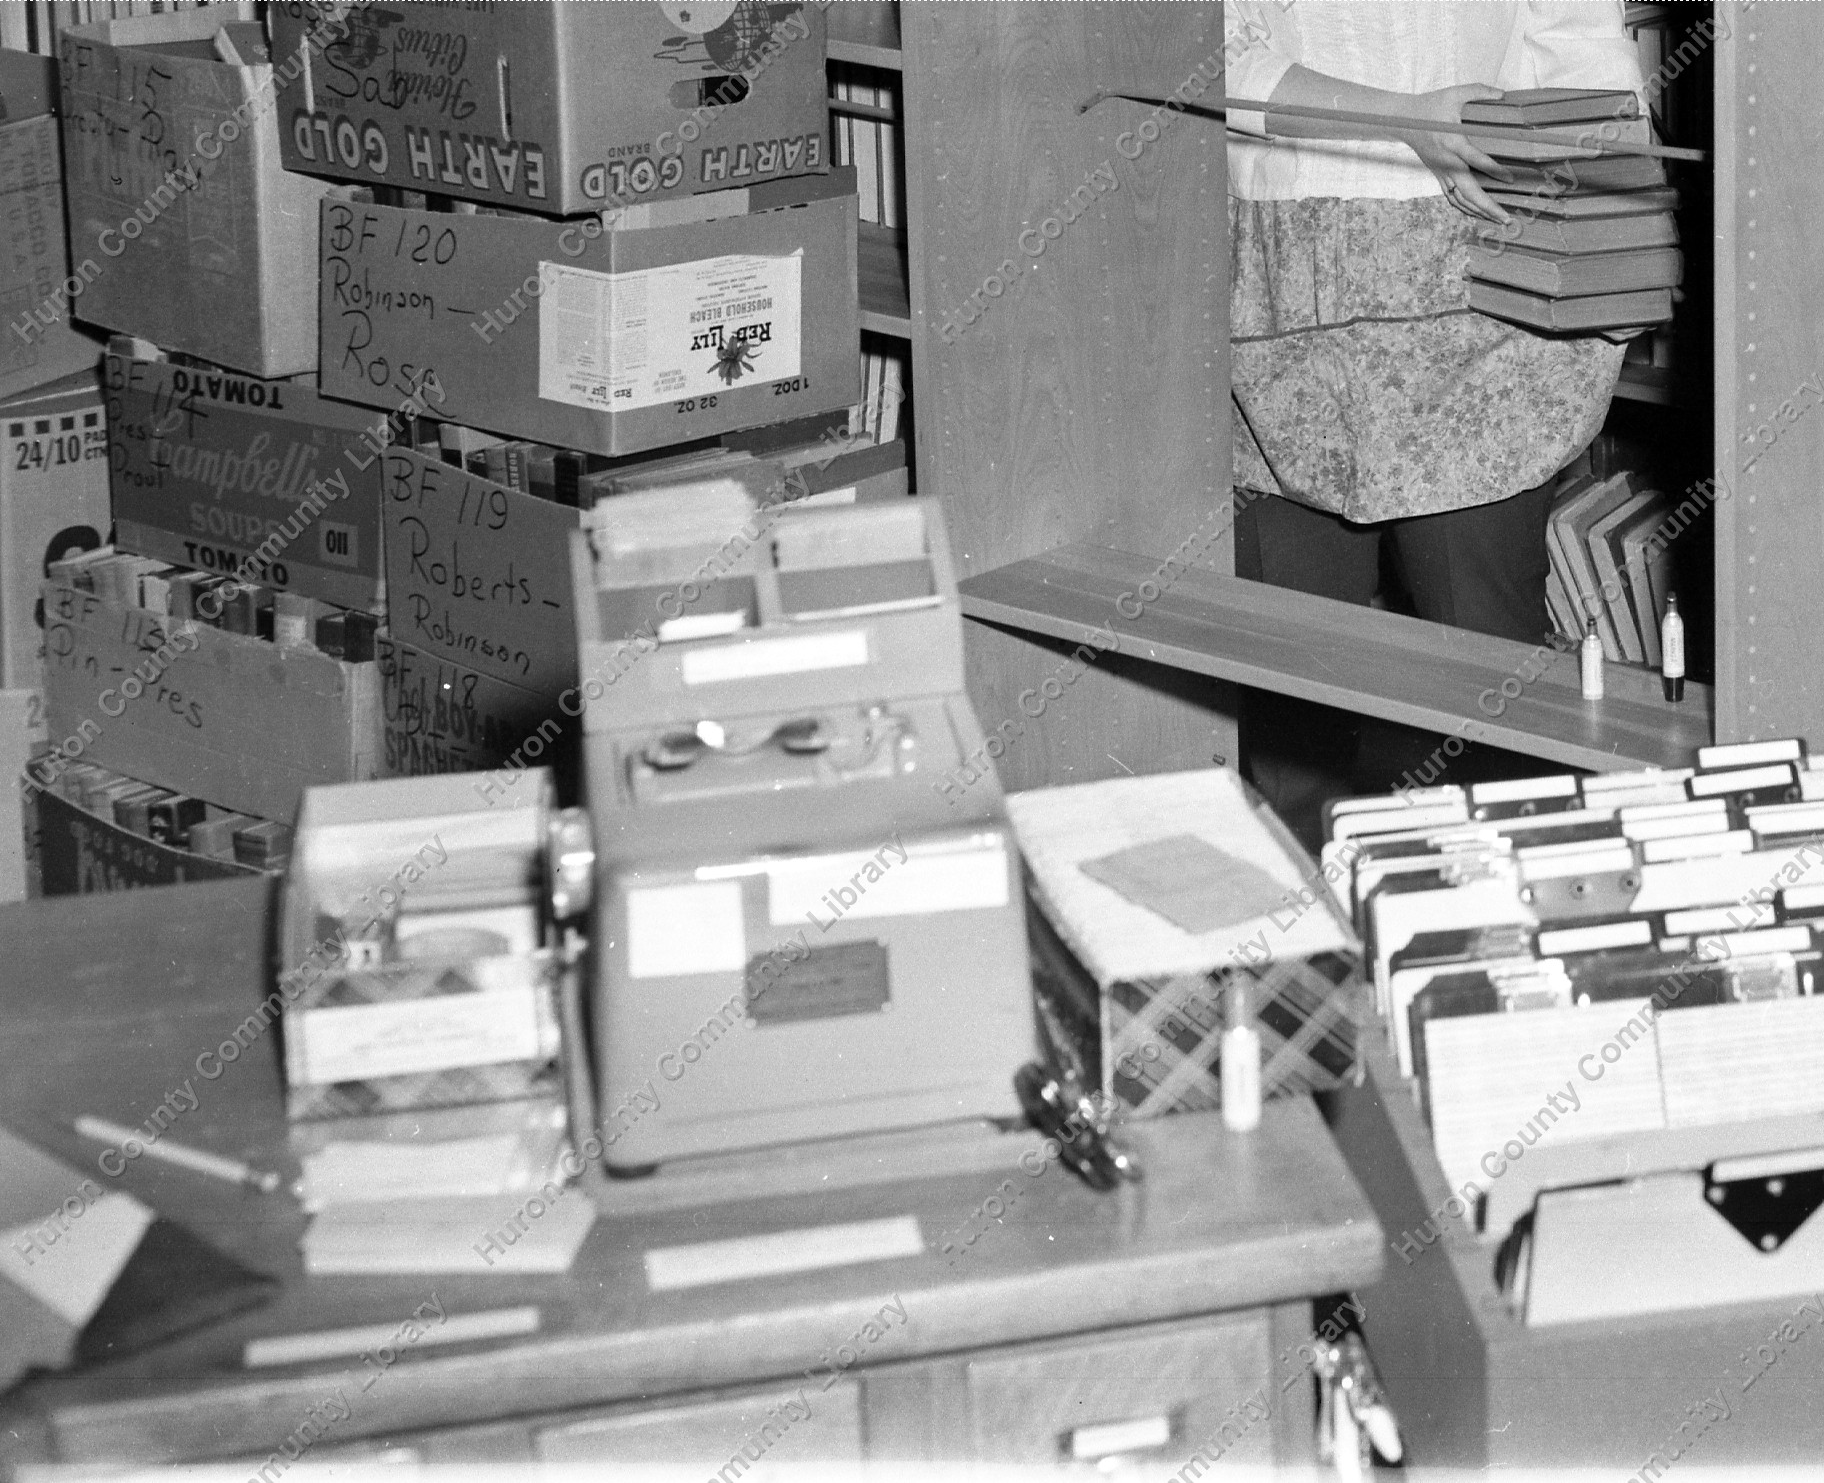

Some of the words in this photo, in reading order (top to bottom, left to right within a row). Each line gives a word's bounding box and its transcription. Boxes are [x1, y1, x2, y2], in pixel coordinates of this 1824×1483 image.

[399, 26, 468, 76] Citrus
[293, 109, 389, 175] GOLD
[404, 123, 548, 200] EARTH
[701, 133, 824, 185] EARTH
[580, 152, 686, 202] GOLD
[329, 205, 378, 253] BF
[403, 219, 457, 265] 120
[326, 256, 434, 320] Robinson
[726, 297, 773, 318] HOUSEHOLD
[690, 306, 723, 324] BLEACH
[690, 325, 725, 351] LILY
[735, 322, 773, 343] RED
[173, 369, 286, 412] TOMATO
[700, 395, 718, 409] 32
[16, 434, 80, 473] 24/10
[388, 455, 441, 509] BF
[456, 481, 509, 530] 119
[399, 516, 532, 606] Roberts
[408, 594, 531, 675] Robinson
